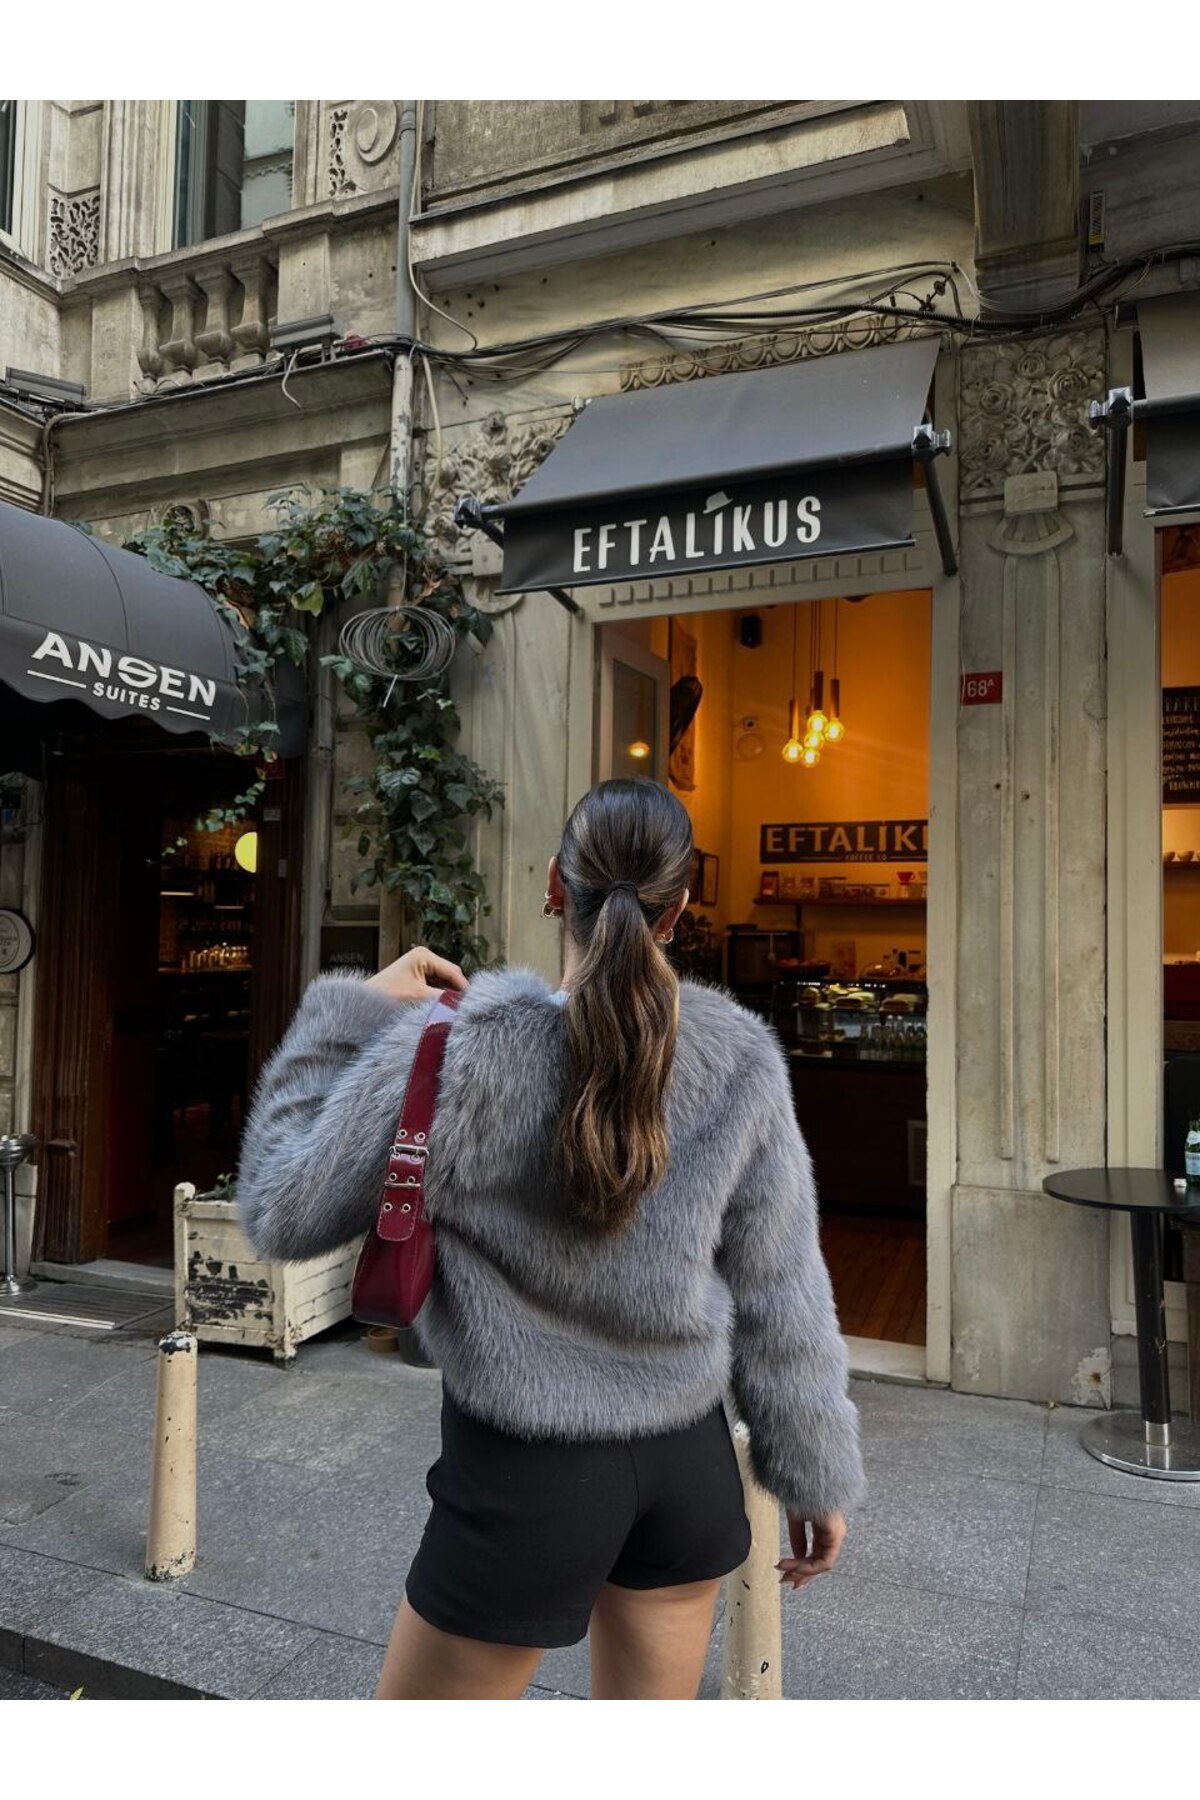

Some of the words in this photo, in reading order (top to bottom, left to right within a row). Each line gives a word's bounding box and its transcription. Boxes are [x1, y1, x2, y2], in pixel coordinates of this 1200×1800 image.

[31, 631, 216, 707] ANSEN
[93, 682, 161, 711] SUITES
[845, 853, 874, 861] COFFEE
